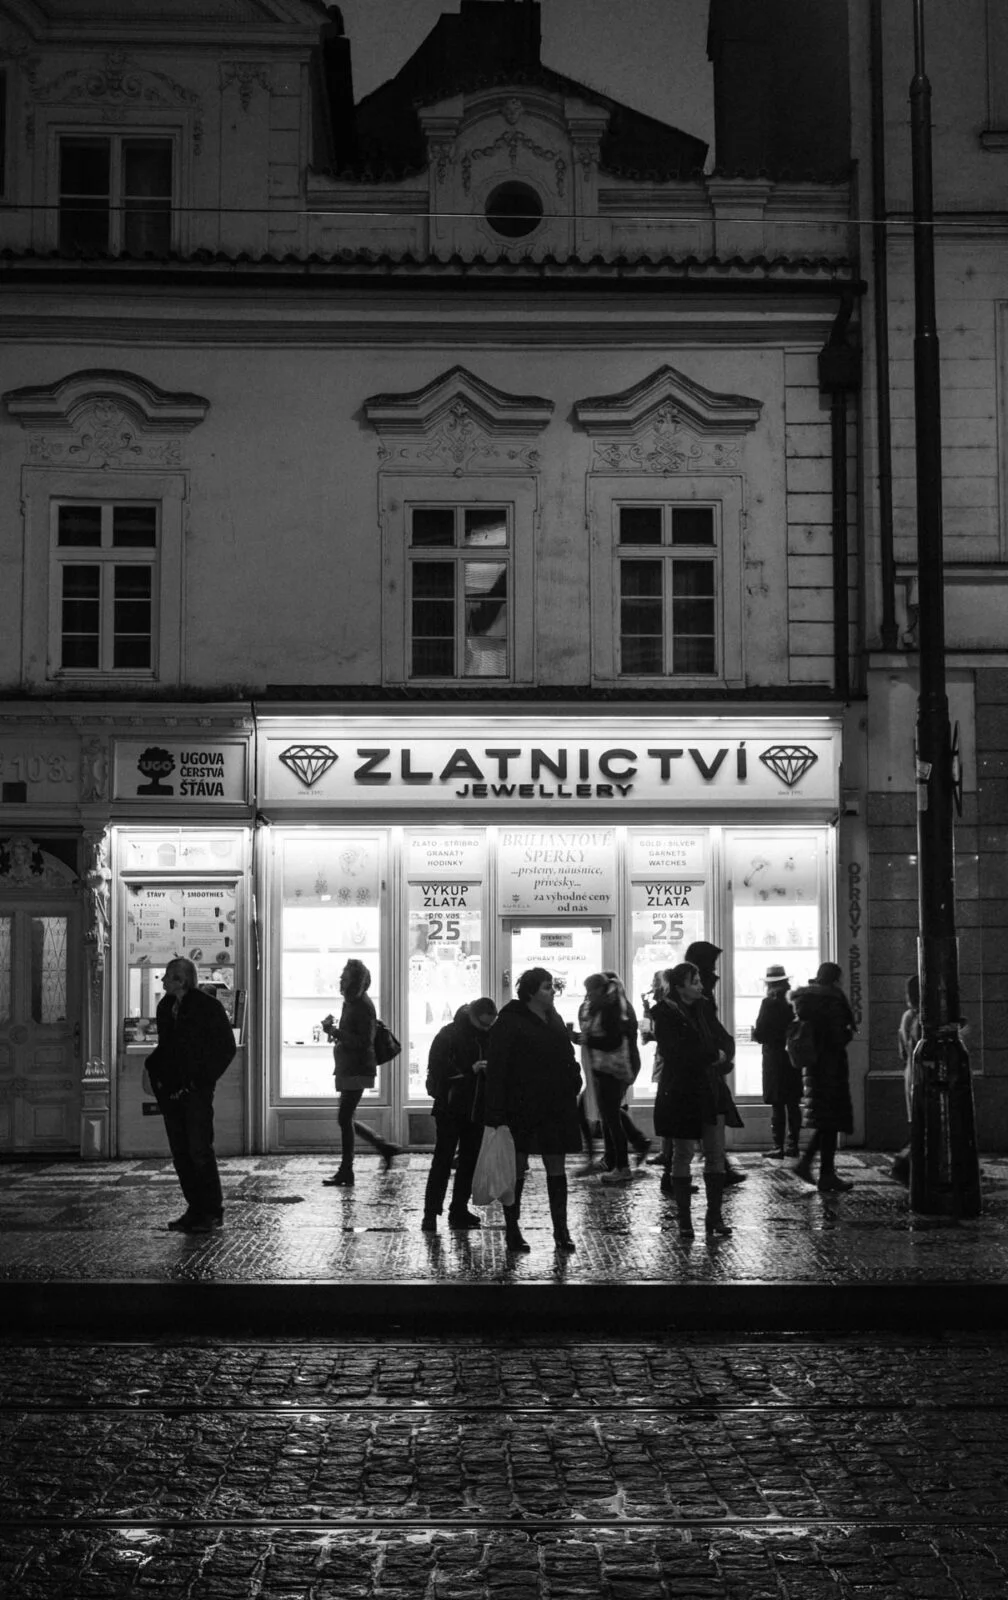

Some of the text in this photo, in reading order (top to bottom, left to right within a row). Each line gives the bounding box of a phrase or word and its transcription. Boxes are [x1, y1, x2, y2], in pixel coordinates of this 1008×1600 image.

[180, 752, 224, 765] UGOVA
[353, 742, 747, 780] ZLATNICTVÍ
[141, 761, 172, 772] UGO
[180, 766, 224, 777] ČERSTVÁ
[180, 779, 224, 796] ŠŤÁVA
[456, 784, 633, 799] JEWELLERY
[422, 884, 469, 896] VÝKUP
[645, 884, 692, 896] VÝKUP
[424, 897, 467, 907] ZLATA
[546, 891, 587, 903] výhodné
[588, 894, 611, 903] ceny
[647, 897, 690, 907] ZLATA
[848, 862, 862, 939] OPRAVY
[557, 903, 588, 912] od nás
[428, 920, 460, 940] 25
[652, 920, 684, 940] 25
